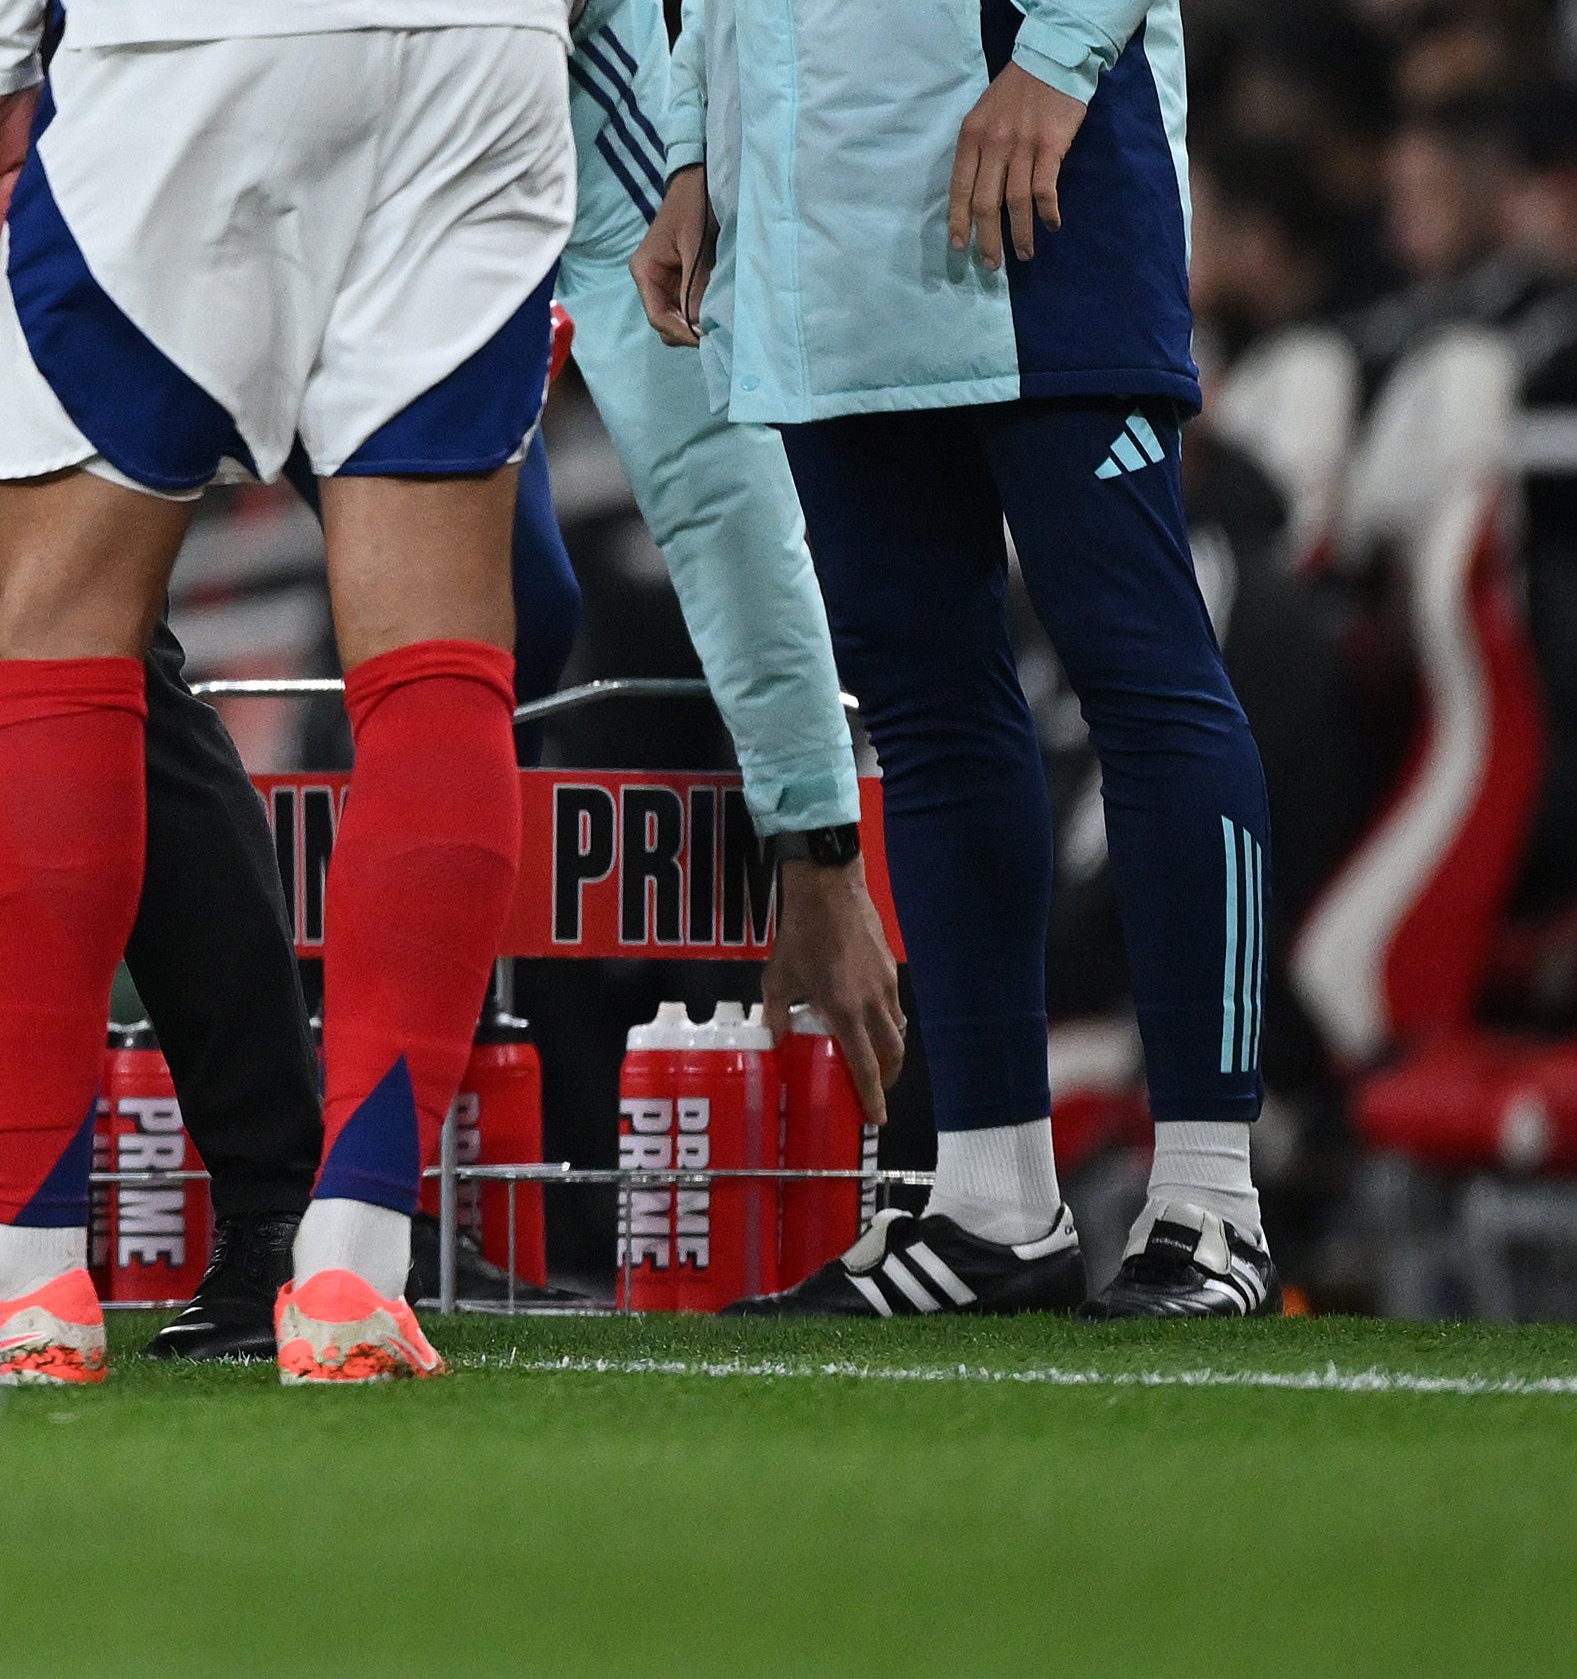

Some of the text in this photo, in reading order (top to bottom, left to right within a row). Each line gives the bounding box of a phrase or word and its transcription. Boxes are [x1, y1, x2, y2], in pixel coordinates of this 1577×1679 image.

[552, 783, 780, 947] PRIM
[117, 1096, 187, 1269] PRIME
[617, 1097, 674, 1269] PRIME
